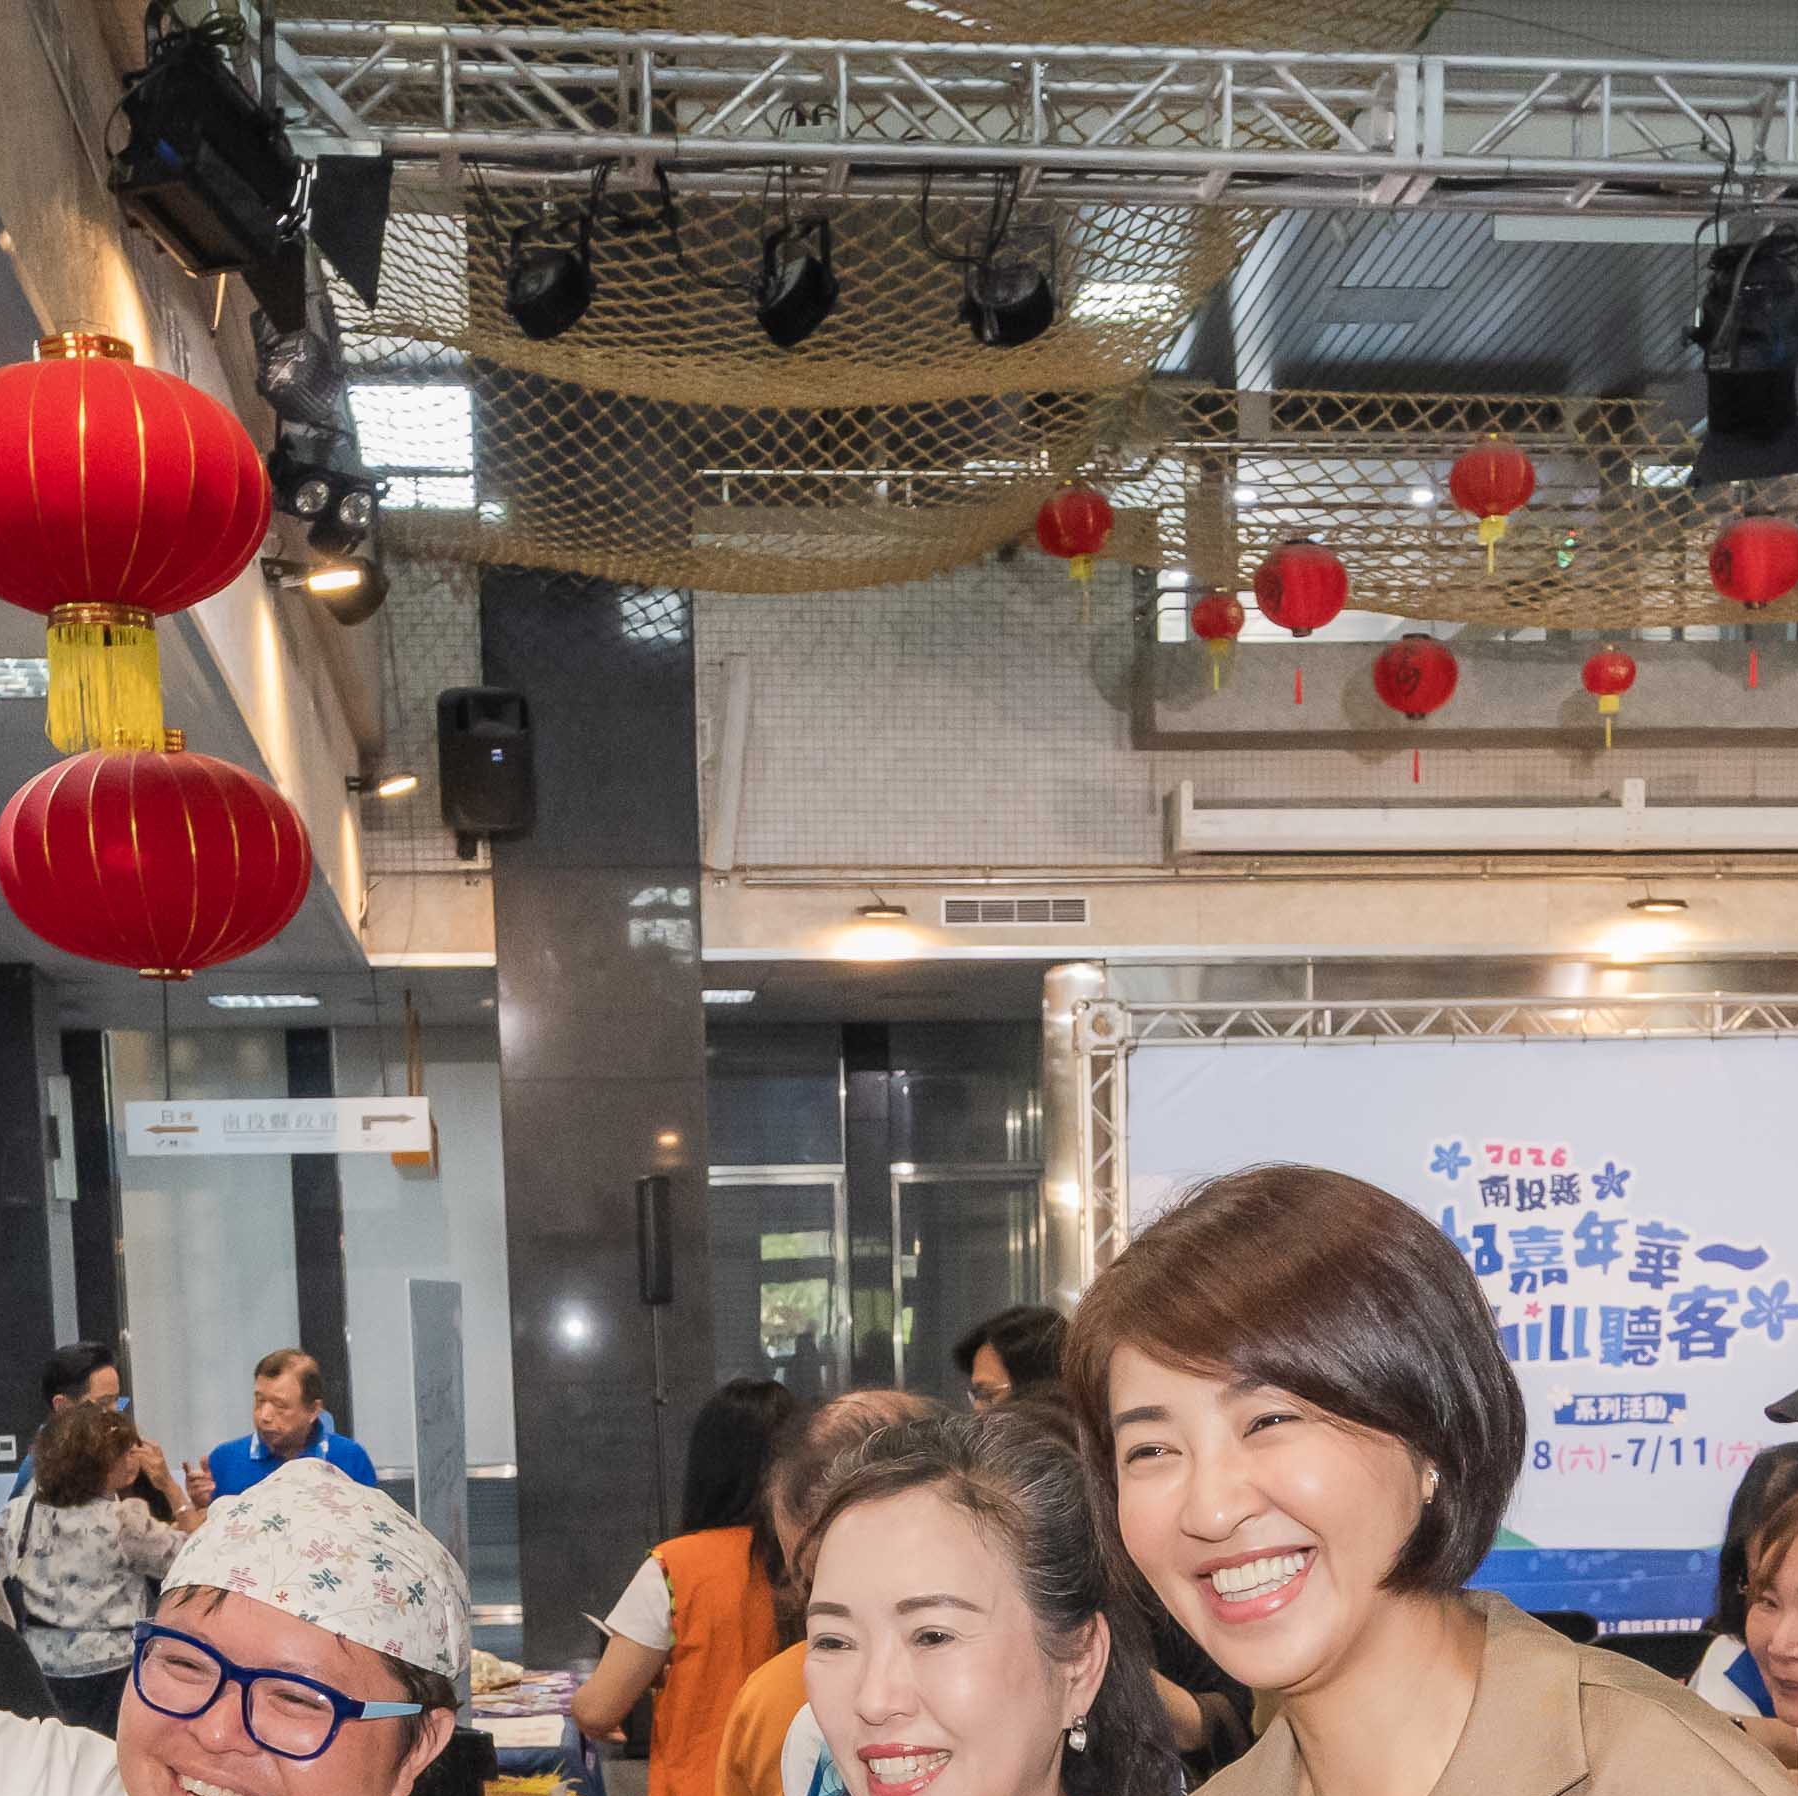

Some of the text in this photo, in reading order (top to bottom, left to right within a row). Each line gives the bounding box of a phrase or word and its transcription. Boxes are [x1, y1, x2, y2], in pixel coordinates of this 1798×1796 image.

[1485, 1144, 1567, 1167] 2026
[1479, 1173, 1582, 1212] 南投縣
[1574, 1395, 1668, 1423] 系列活動
